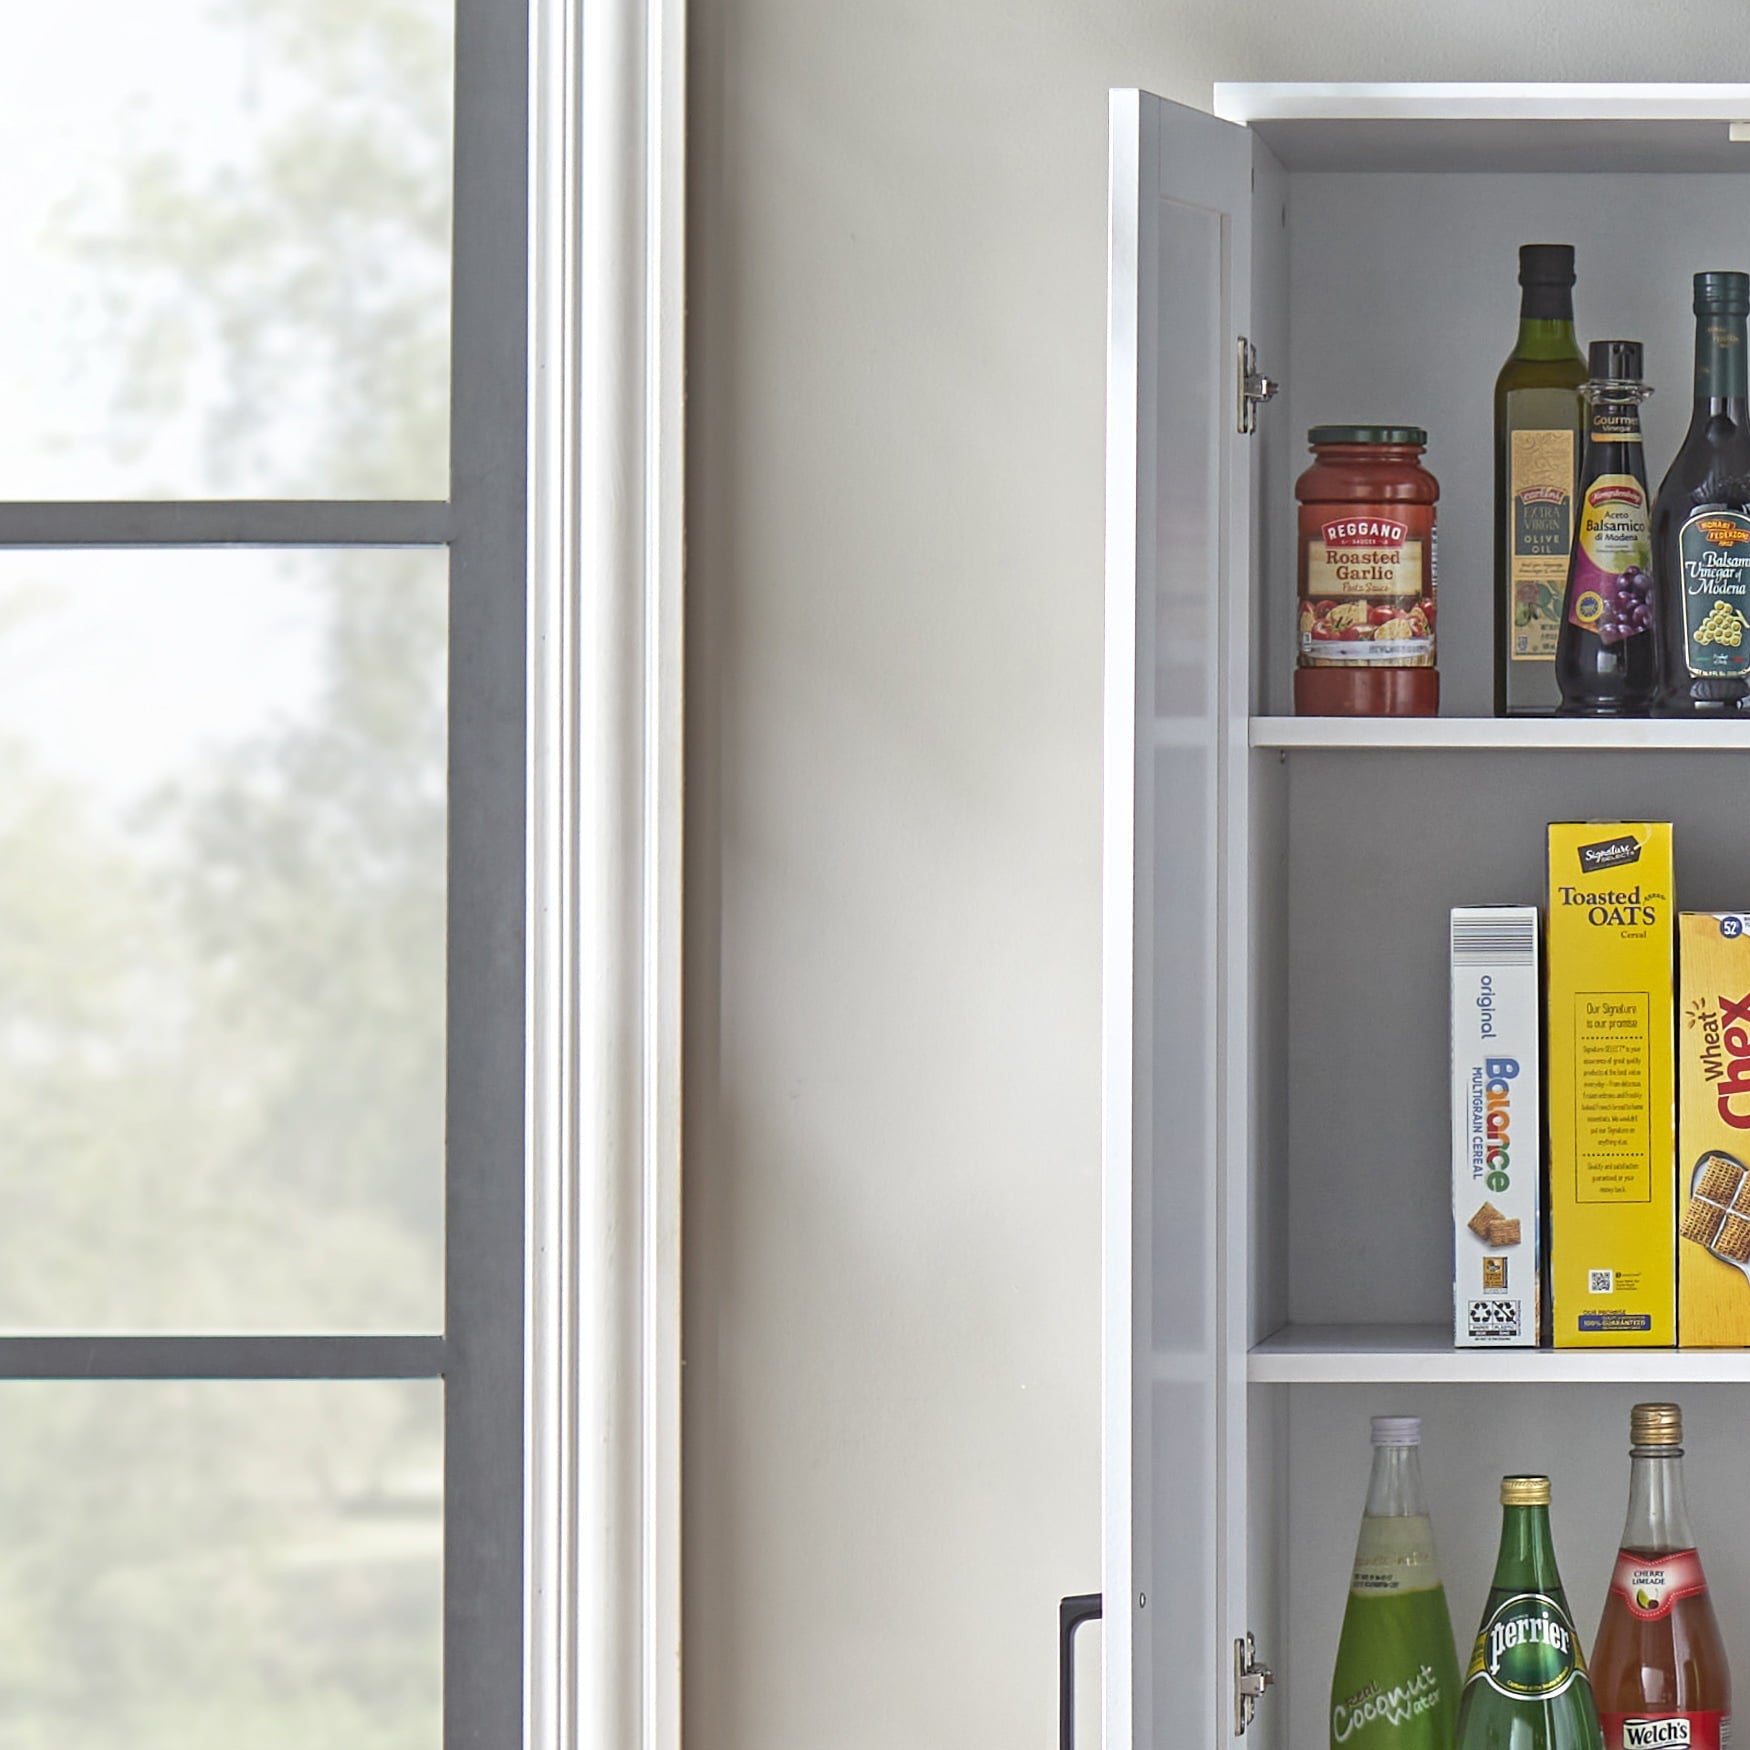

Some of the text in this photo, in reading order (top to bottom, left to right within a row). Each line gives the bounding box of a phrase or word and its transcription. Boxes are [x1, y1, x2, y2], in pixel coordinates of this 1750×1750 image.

[1523, 506, 1561, 518] EXTRA
[1604, 511, 1629, 520] Aceto
[1327, 522, 1402, 541] REGGANO
[1523, 519, 1561, 530] VIRGIN
[1585, 519, 1646, 532] Balsamico
[1523, 534, 1561, 544] OLIVE
[1604, 533, 1638, 542] Modena
[1325, 550, 1401, 565] Roasted
[1531, 545, 1553, 554] OIL
[1336, 565, 1394, 580] Garlic
[1684, 560, 1736, 584] Vinegar
[1688, 578, 1747, 596] Modena
[1585, 844, 1631, 864] Signature
[1558, 885, 1641, 906] Toasted
[1588, 905, 1656, 927] OATS
[1620, 930, 1647, 939] Cereal
[1476, 975, 1497, 1040] original
[1586, 1002, 1638, 1016] Our Signature
[1697, 1011, 1724, 1082] Wheat
[1472, 1066, 1484, 1180] MULTIGRAIN CEREAL
[1485, 1057, 1521, 1193] Balance
[1333, 1665, 1437, 1743] Coconut
[1385, 1688, 1440, 1727] Water
[1627, 1721, 1689, 1746] Welch's
